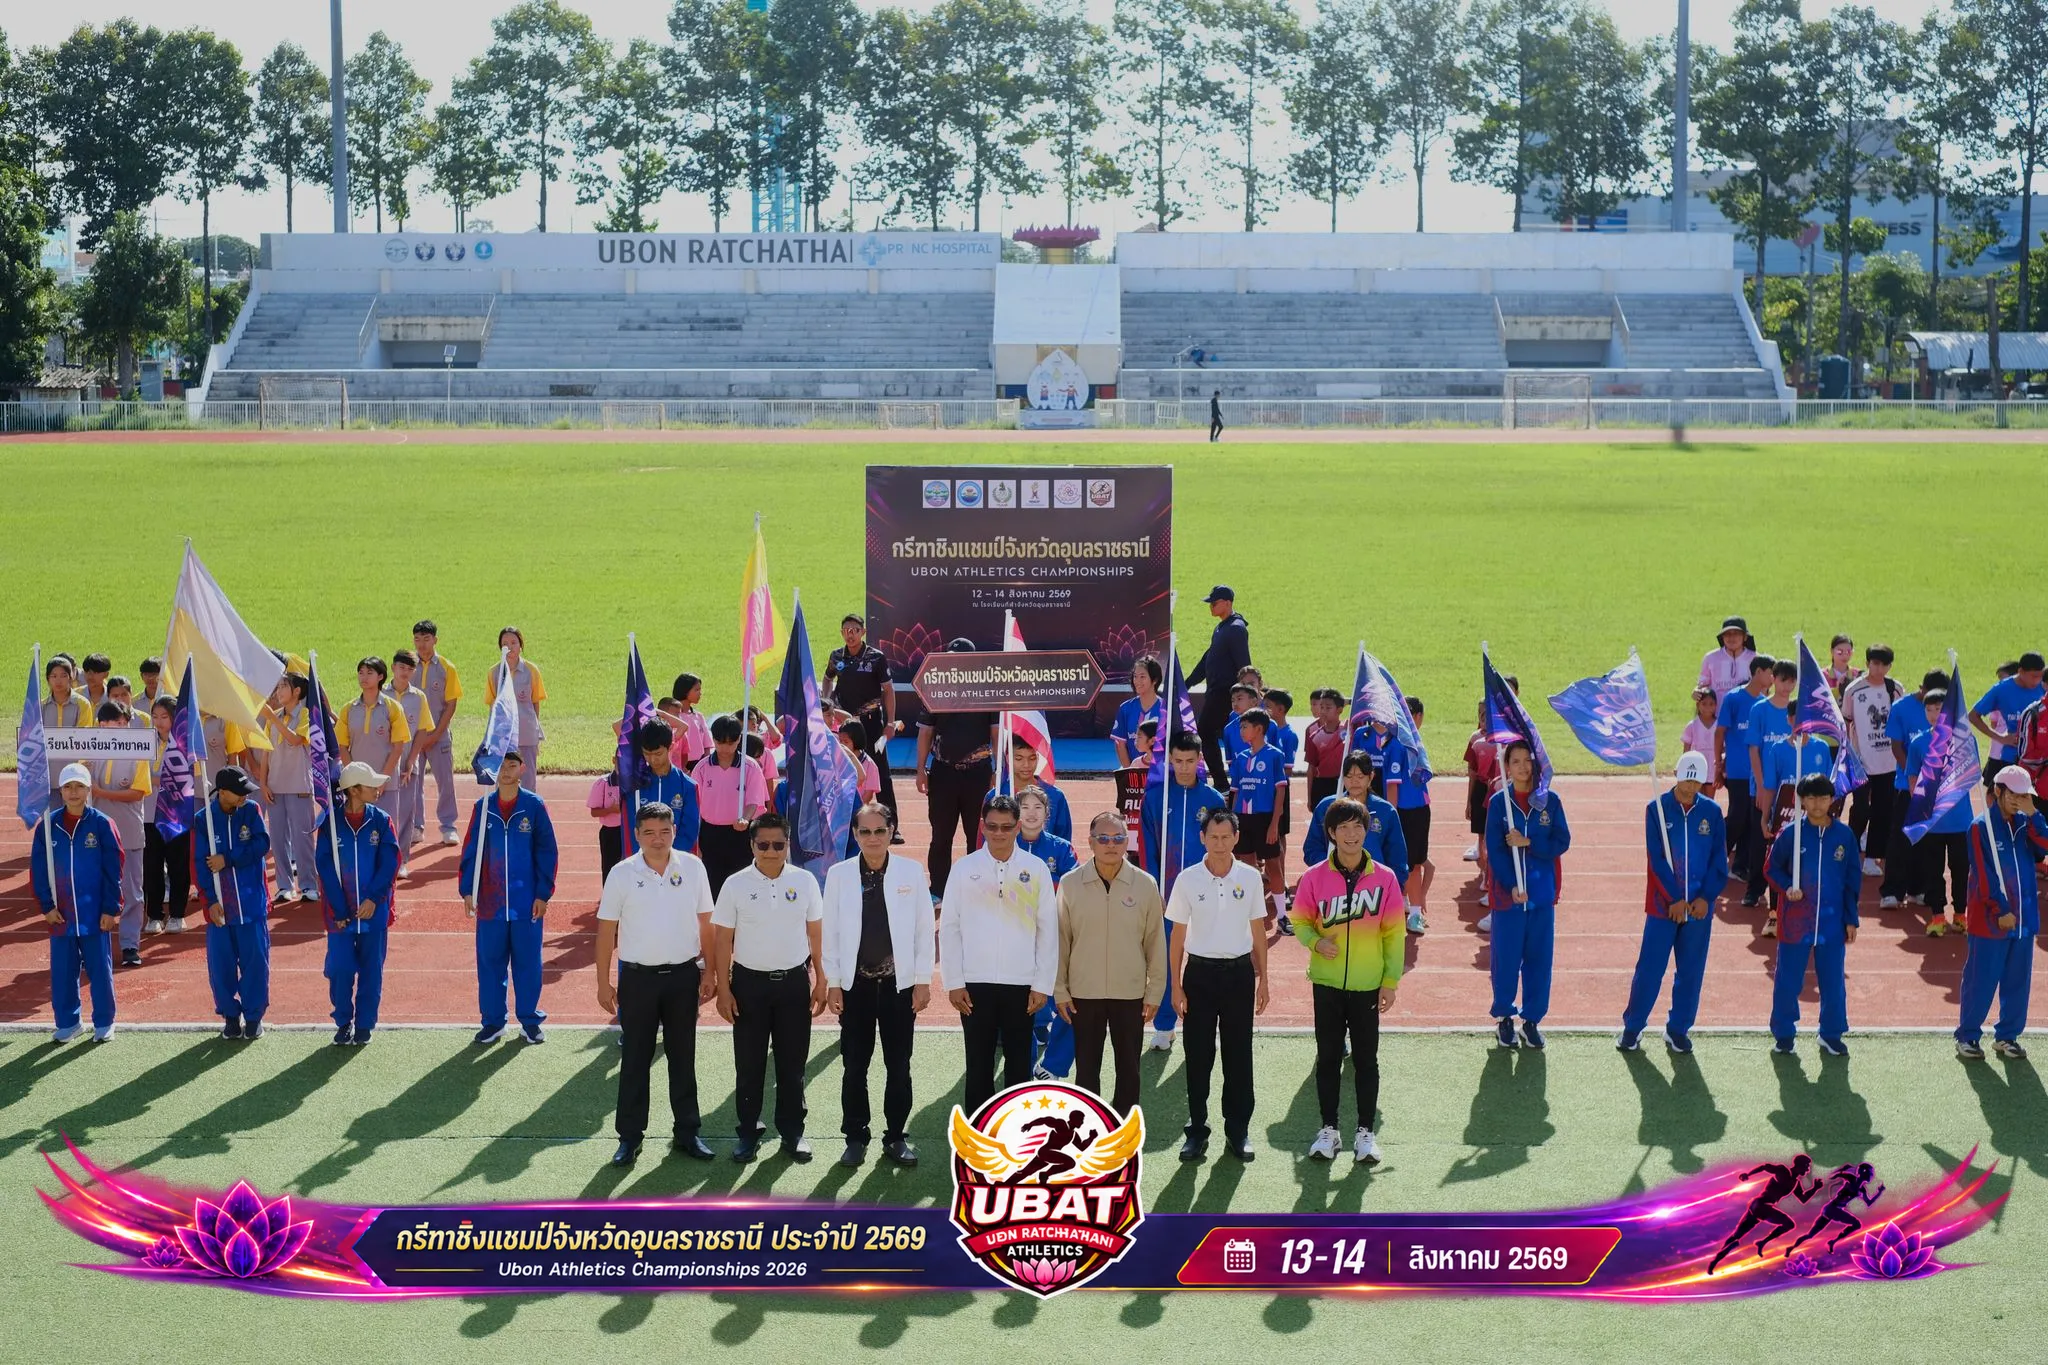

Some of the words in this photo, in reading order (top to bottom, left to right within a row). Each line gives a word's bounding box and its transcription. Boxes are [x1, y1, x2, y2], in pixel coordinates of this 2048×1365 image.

[597, 239, 677, 264] UBON
[688, 239, 853, 264] RATCHATHA
[932, 243, 993, 254] HOSPITAL
[892, 536, 1150, 565] กรีฑาชิงแชมป์จังหวัดอุบลราชธานี
[911, 567, 948, 577] UBON
[954, 566, 1026, 577] ATHLETICS
[1031, 566, 1135, 577] CHAMPIONSHIPS
[972, 589, 983, 598] 12
[995, 589, 1005, 598] 14
[1008, 588, 1045, 598] สิงหาคม
[1048, 588, 1072, 599] 2569
[923, 664, 1090, 687] กรีฑาชิงแชมป์จังหวัดอุบลราชธานี
[931, 690, 957, 698] UBON
[961, 689, 1011, 697] ATHLETICS
[1015, 687, 1087, 697] CHAMPIONSHIPS
[1318, 886, 1384, 928] UBN
